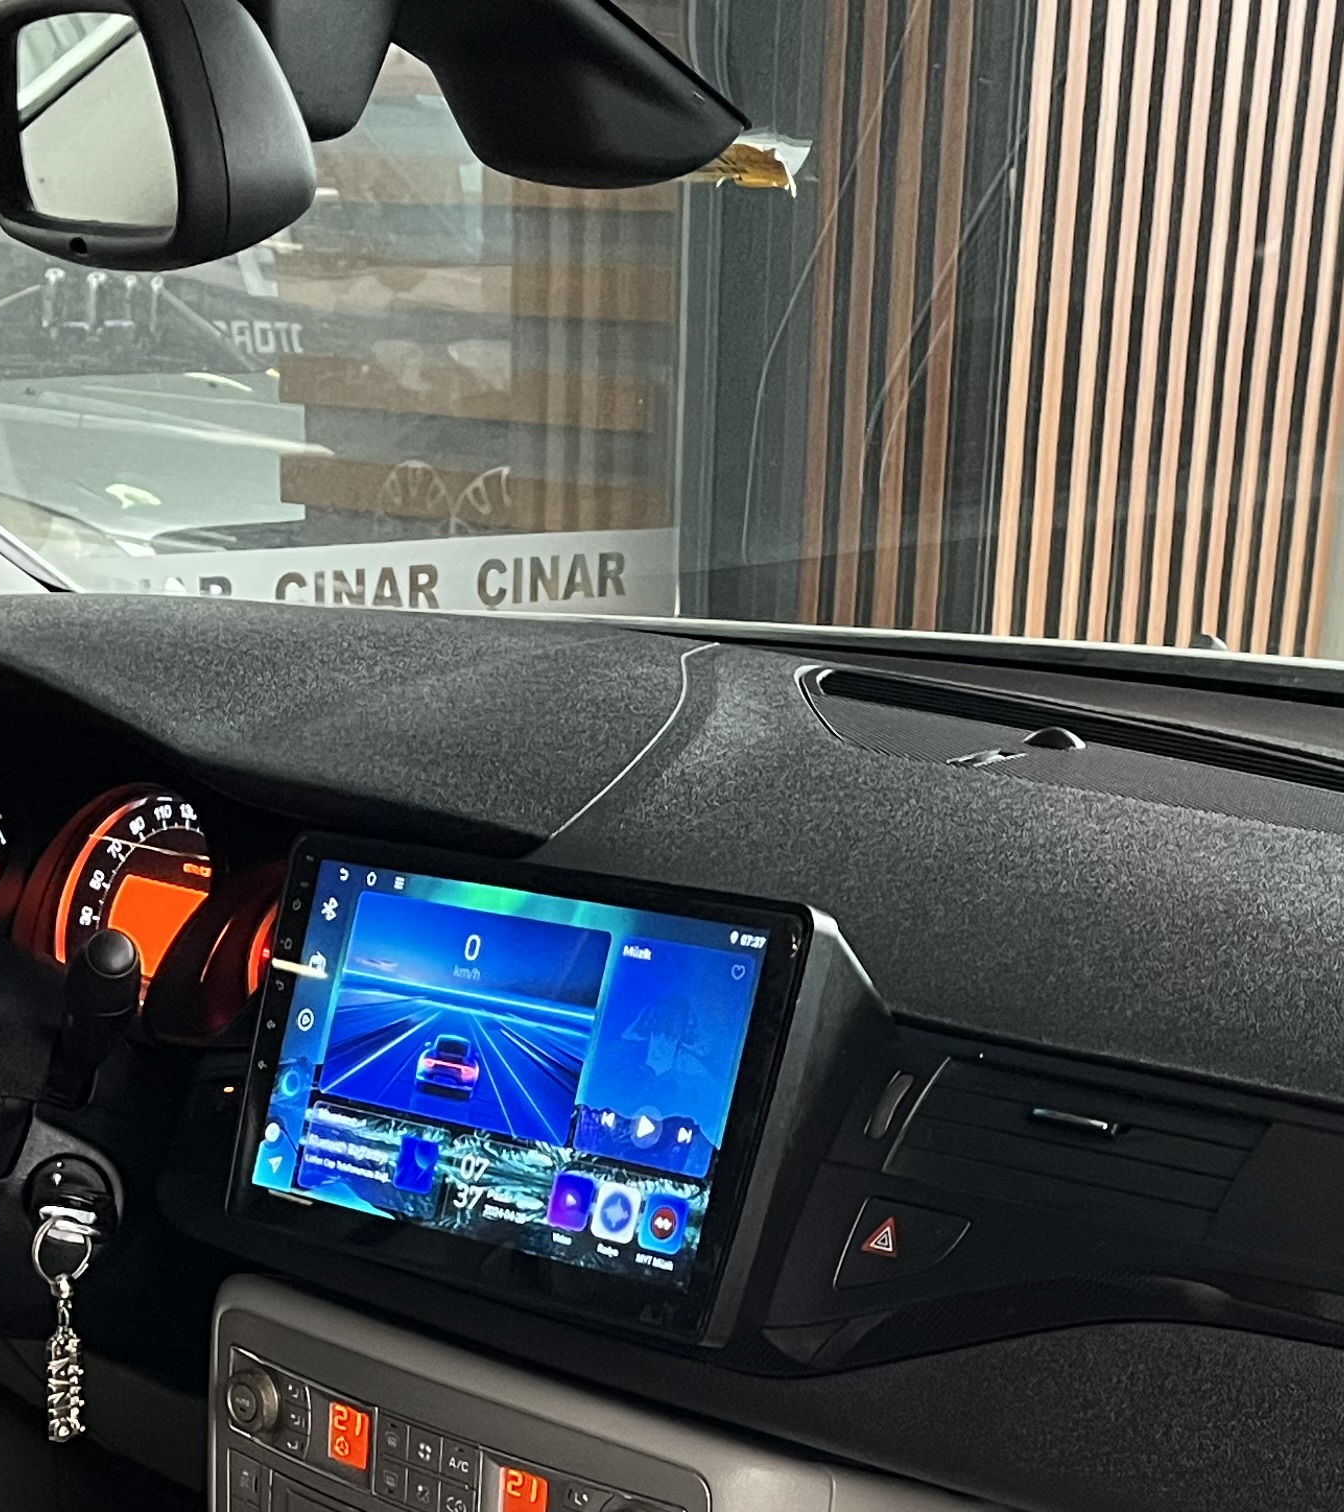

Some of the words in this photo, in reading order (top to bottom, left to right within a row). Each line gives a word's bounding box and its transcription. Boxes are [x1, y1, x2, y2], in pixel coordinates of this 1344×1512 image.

[464, 934, 481, 962] 0
[453, 964, 480, 980] km/h
[459, 1154, 490, 1181] 07
[453, 1183, 484, 1210] 37
[332, 1404, 363, 1437] 21
[448, 1456, 470, 1473] A/C
[506, 1468, 538, 1503] 21
